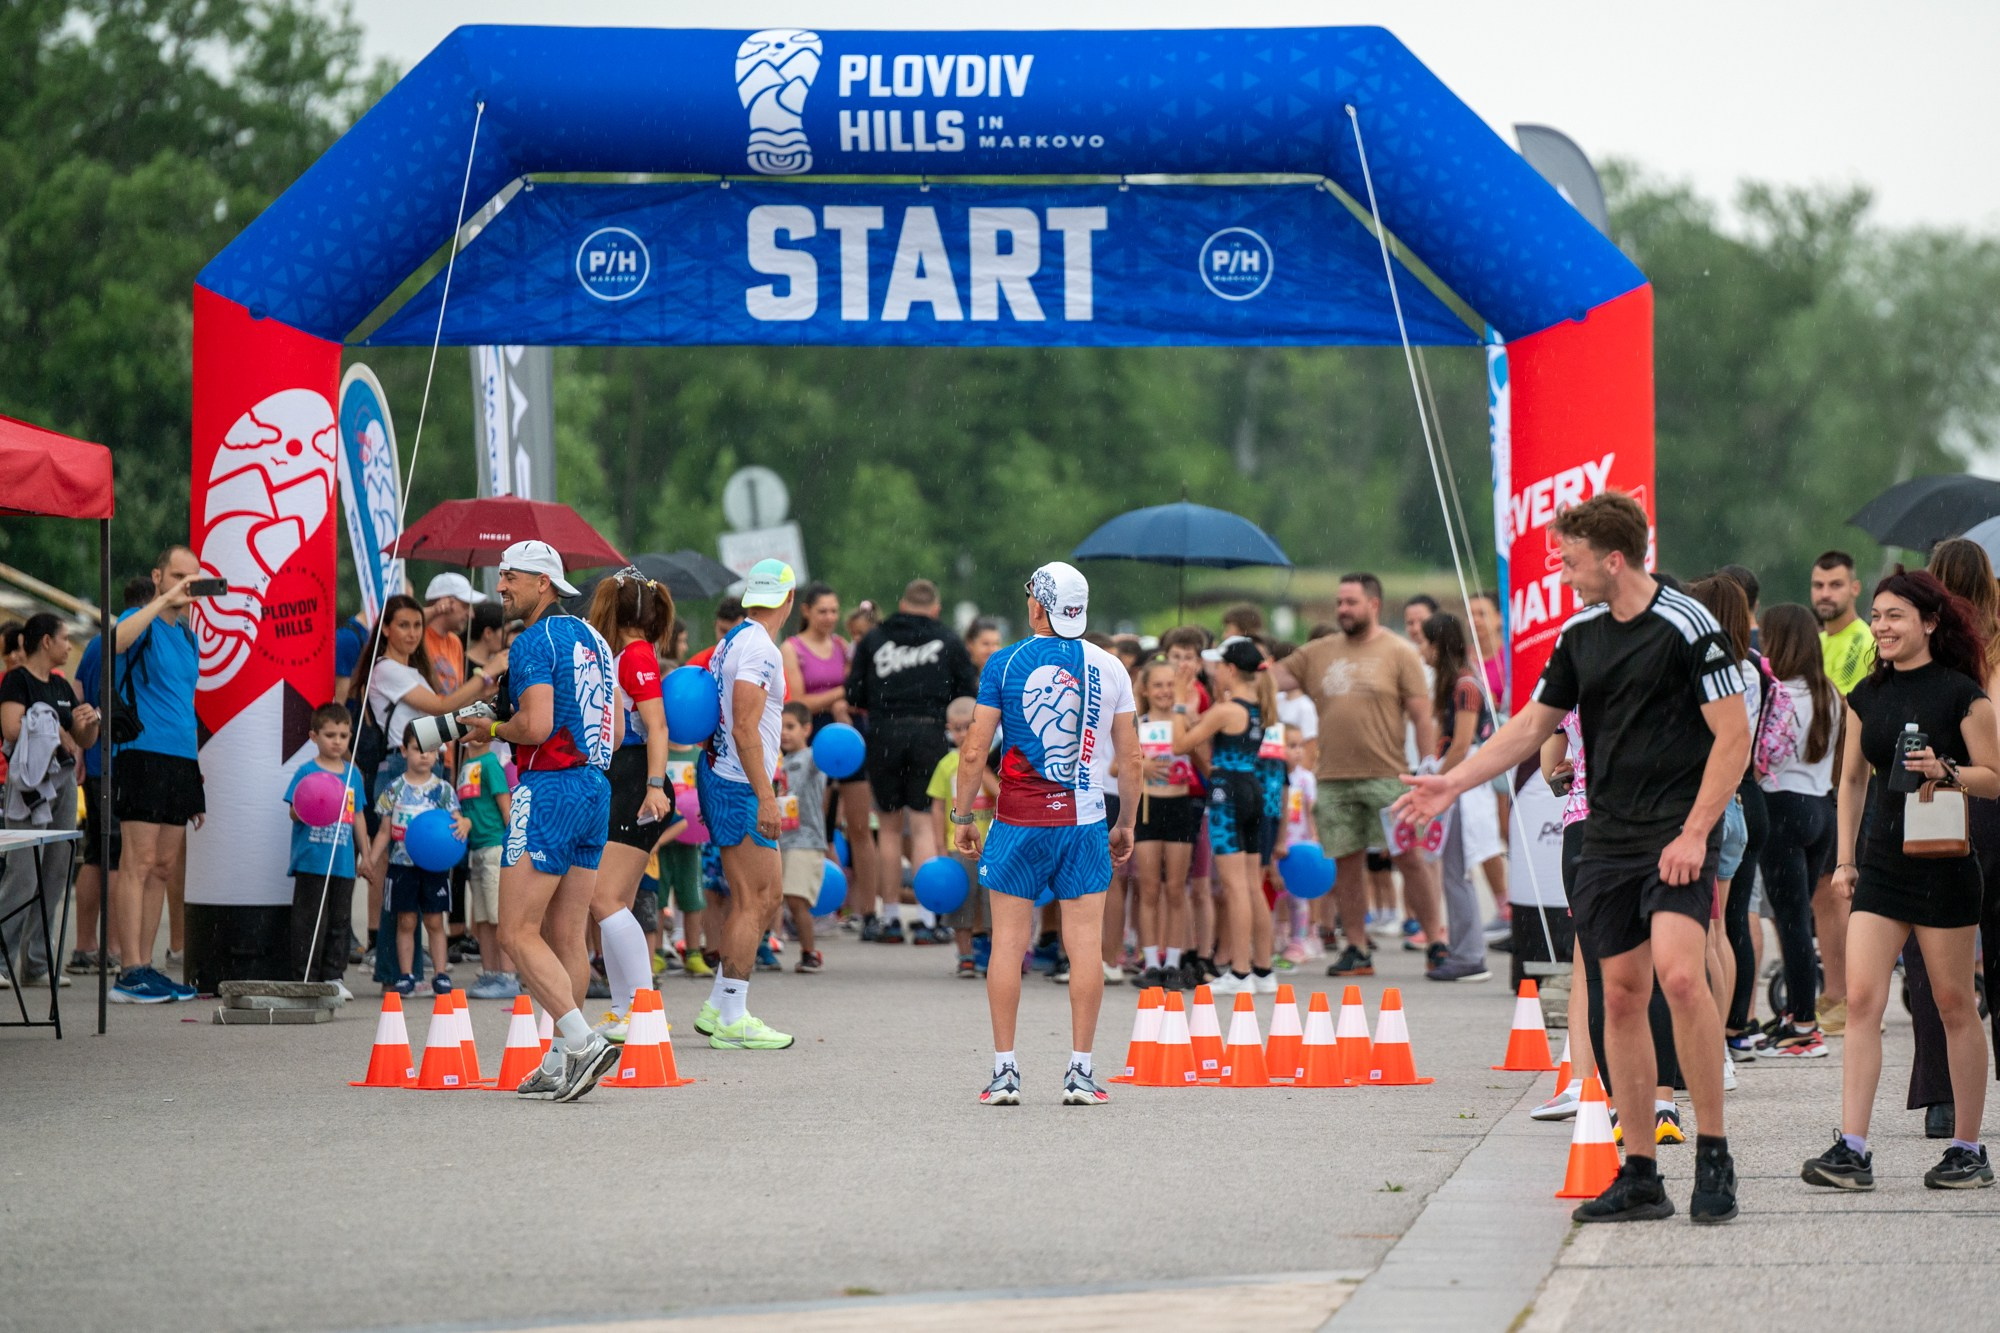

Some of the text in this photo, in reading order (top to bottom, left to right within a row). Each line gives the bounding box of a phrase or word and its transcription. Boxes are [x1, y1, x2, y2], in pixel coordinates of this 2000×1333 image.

[839, 54, 1034, 98] PLOVDIV
[839, 110, 966, 152] HILLS
[978, 116, 1004, 130] IN
[979, 135, 1106, 149] MARKOVO
[589, 250, 637, 274] P/H
[745, 205, 1108, 322] START
[1212, 249, 1260, 274] P/H
[1509, 452, 1615, 548] VERY
[260, 596, 318, 622] PLOVDIV
[275, 617, 313, 639] HILLS
[1086, 664, 1101, 729] MATTERS
[601, 705, 612, 743] STEP
[1081, 728, 1096, 764] STEP
